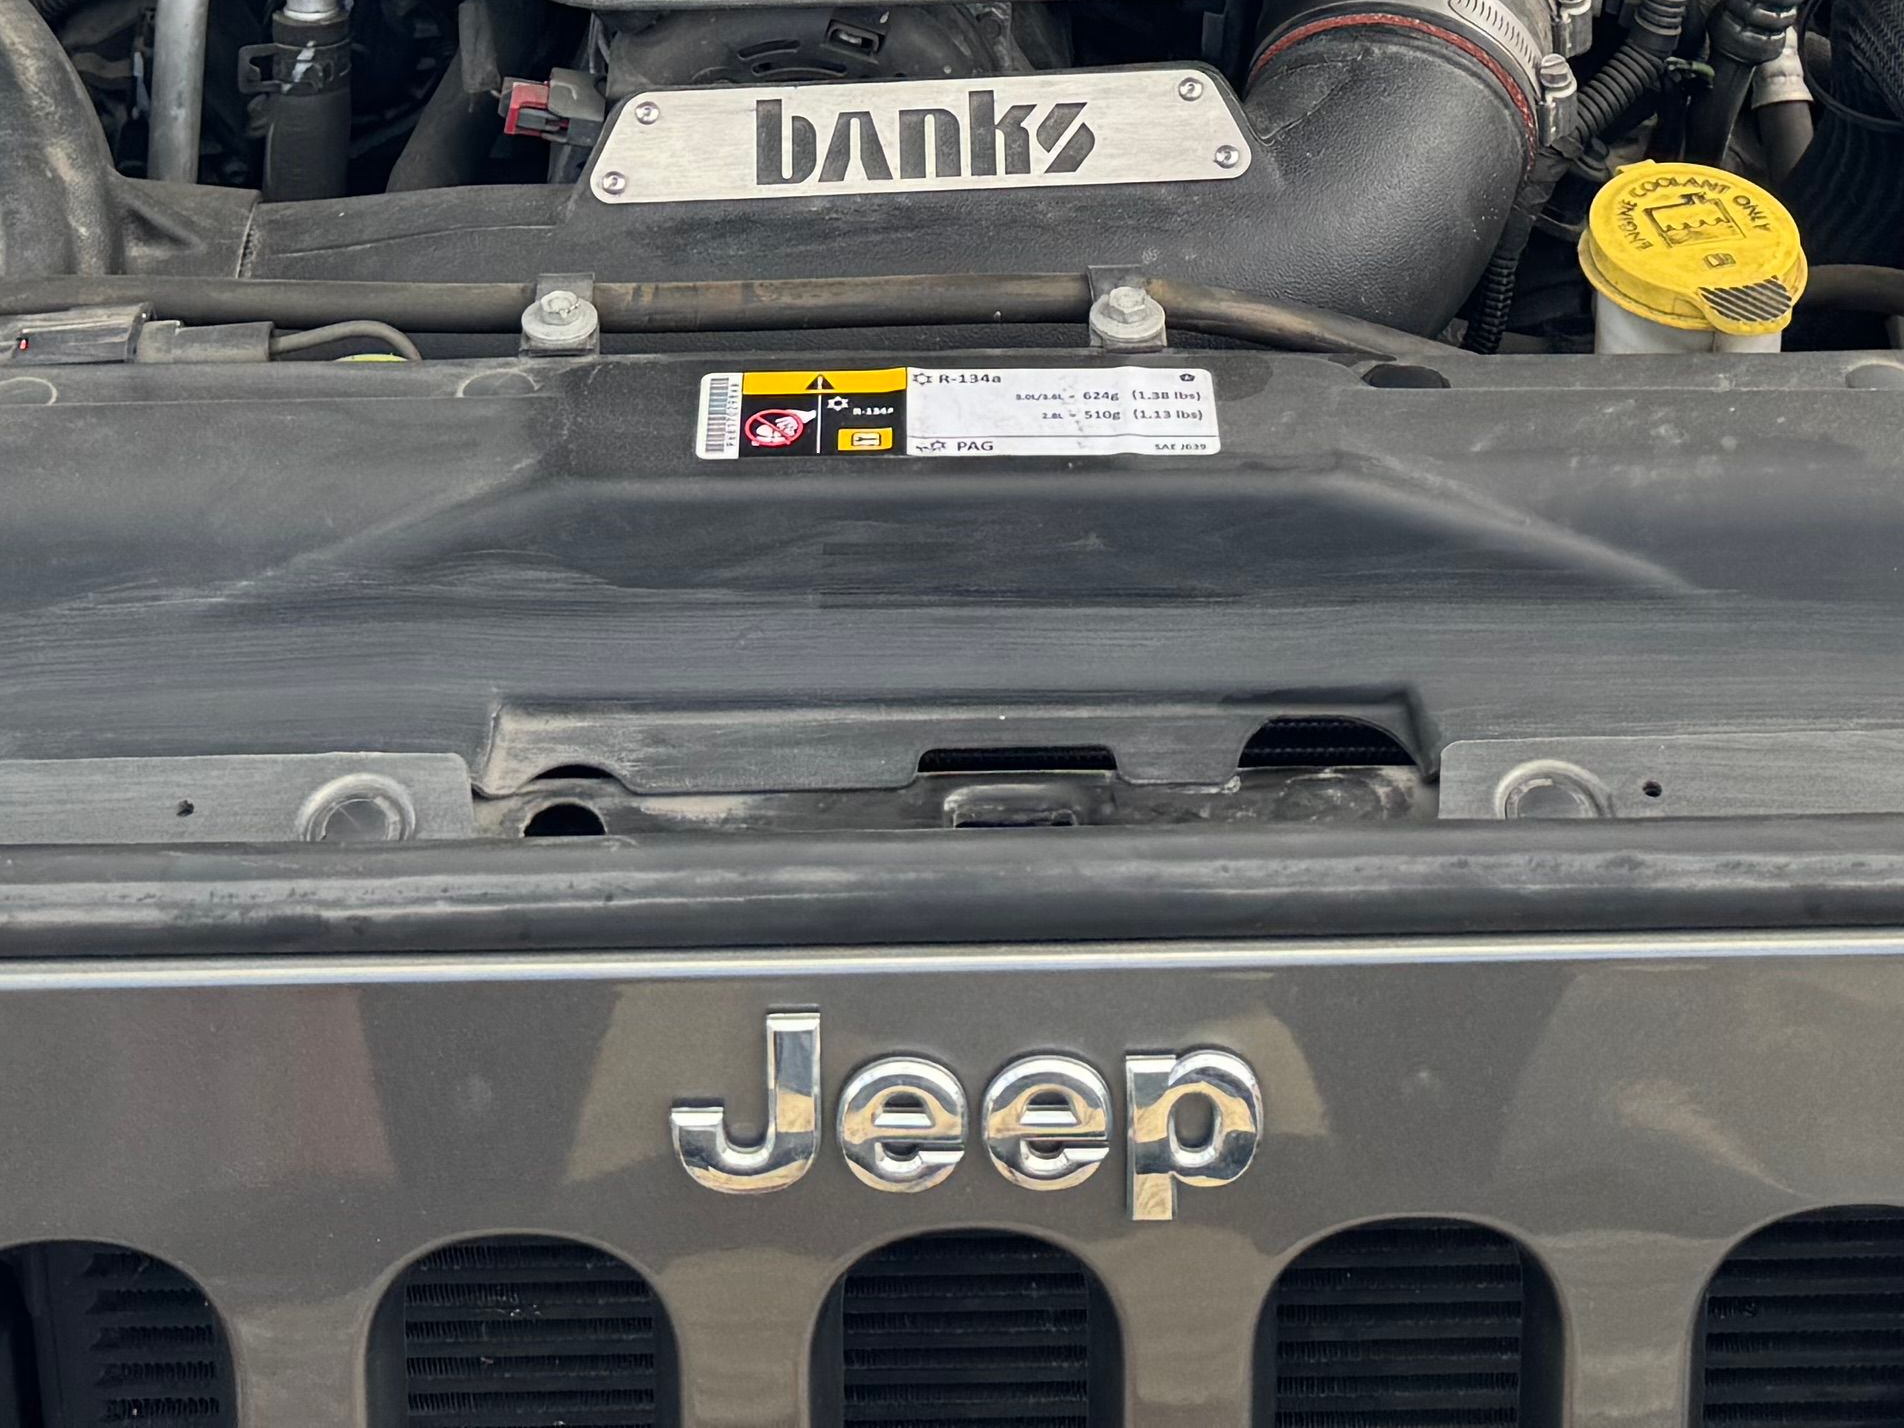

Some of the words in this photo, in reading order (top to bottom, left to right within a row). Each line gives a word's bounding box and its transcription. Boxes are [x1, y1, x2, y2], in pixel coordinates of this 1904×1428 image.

[755, 91, 1096, 187] banks
[1629, 177, 1730, 198] COOLANT
[1733, 194, 1771, 233] ONLY
[1615, 199, 1653, 251] ENGINE
[938, 373, 1002, 384] R-134a
[1083, 390, 1119, 402] 624g
[1174, 390, 1201, 401] lbs)
[1084, 409, 1121, 421] 510g
[1133, 409, 1171, 421] (1.13
[1176, 409, 1203, 421] lbs)
[957, 441, 994, 451] PAG
[669, 1009, 1265, 1221] Jeep
